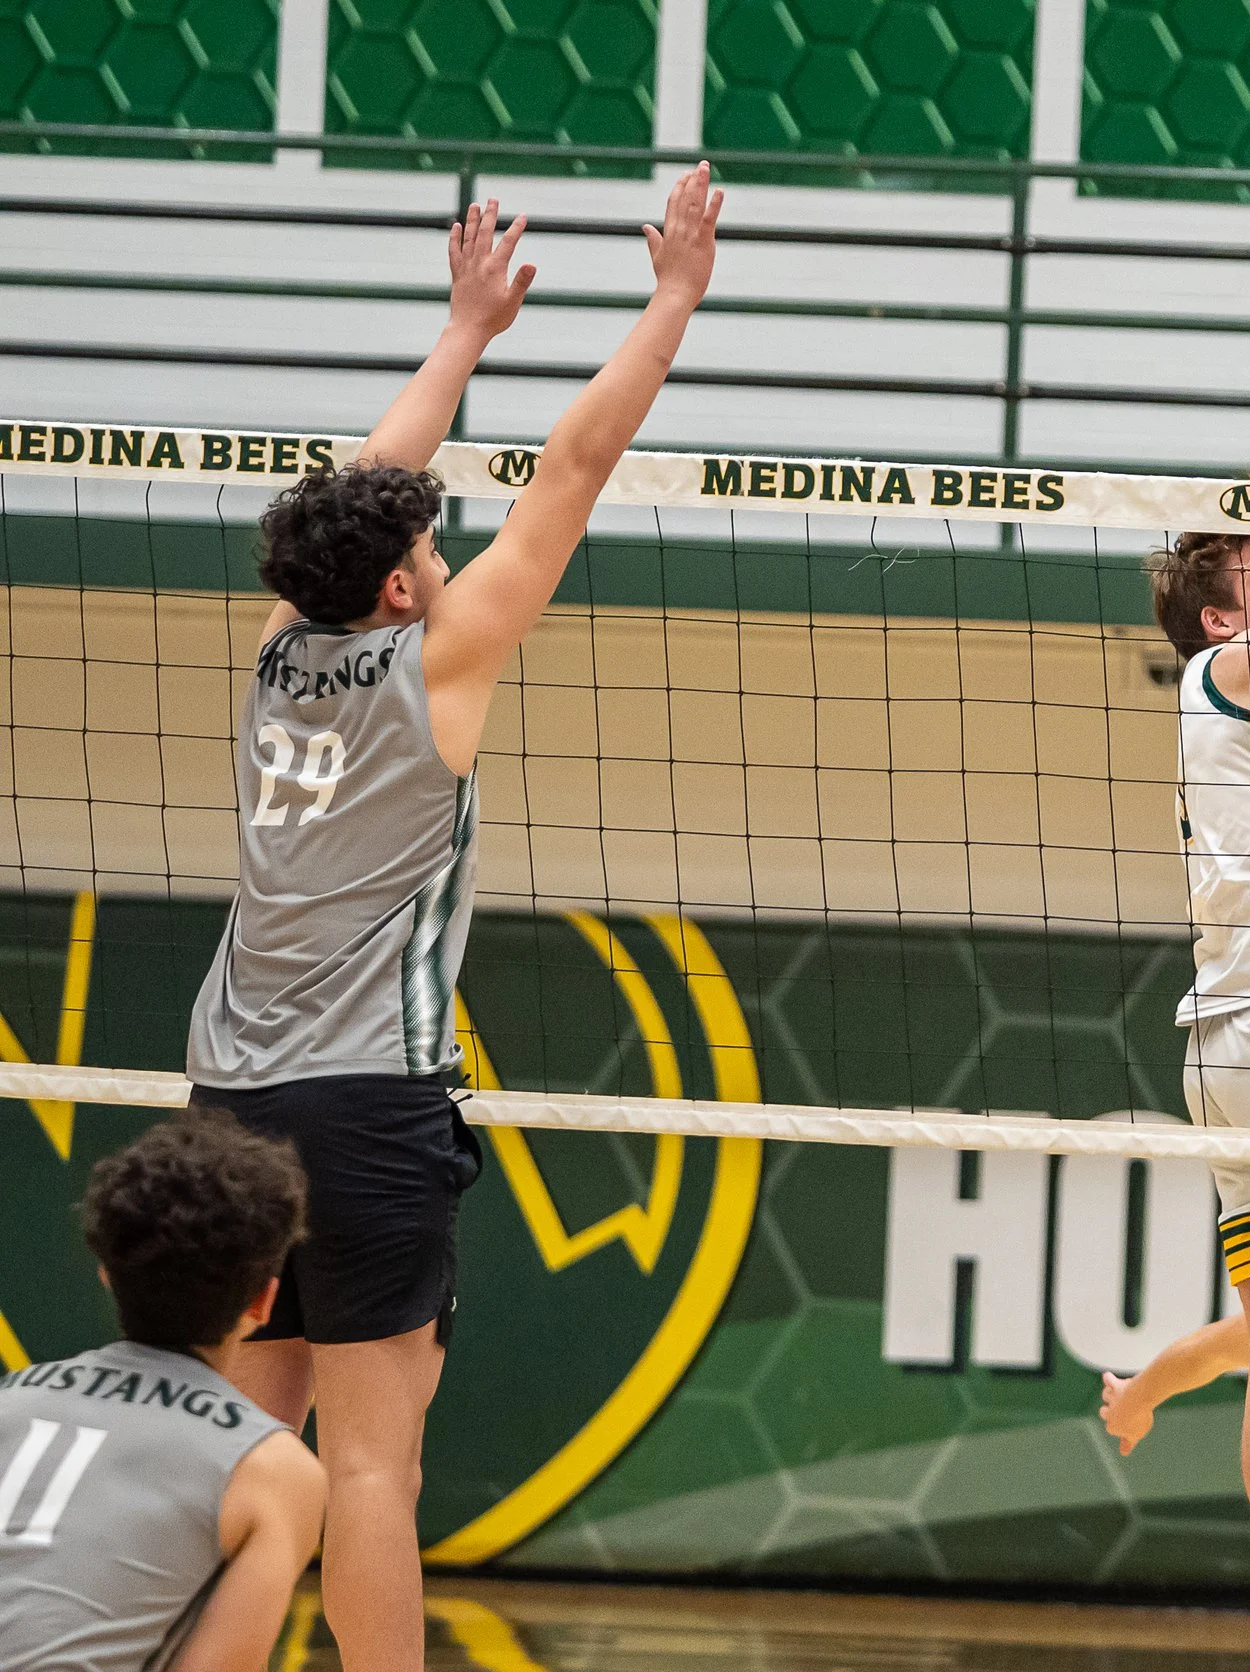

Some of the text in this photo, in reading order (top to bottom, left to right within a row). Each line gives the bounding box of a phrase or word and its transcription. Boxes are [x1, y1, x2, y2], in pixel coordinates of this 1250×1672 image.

[200, 434, 334, 474] BEES
[496, 450, 536, 487] M
[700, 459, 1065, 512] MEDINA BEES
[250, 724, 347, 826] 29
[0, 1418, 109, 1545] 11
